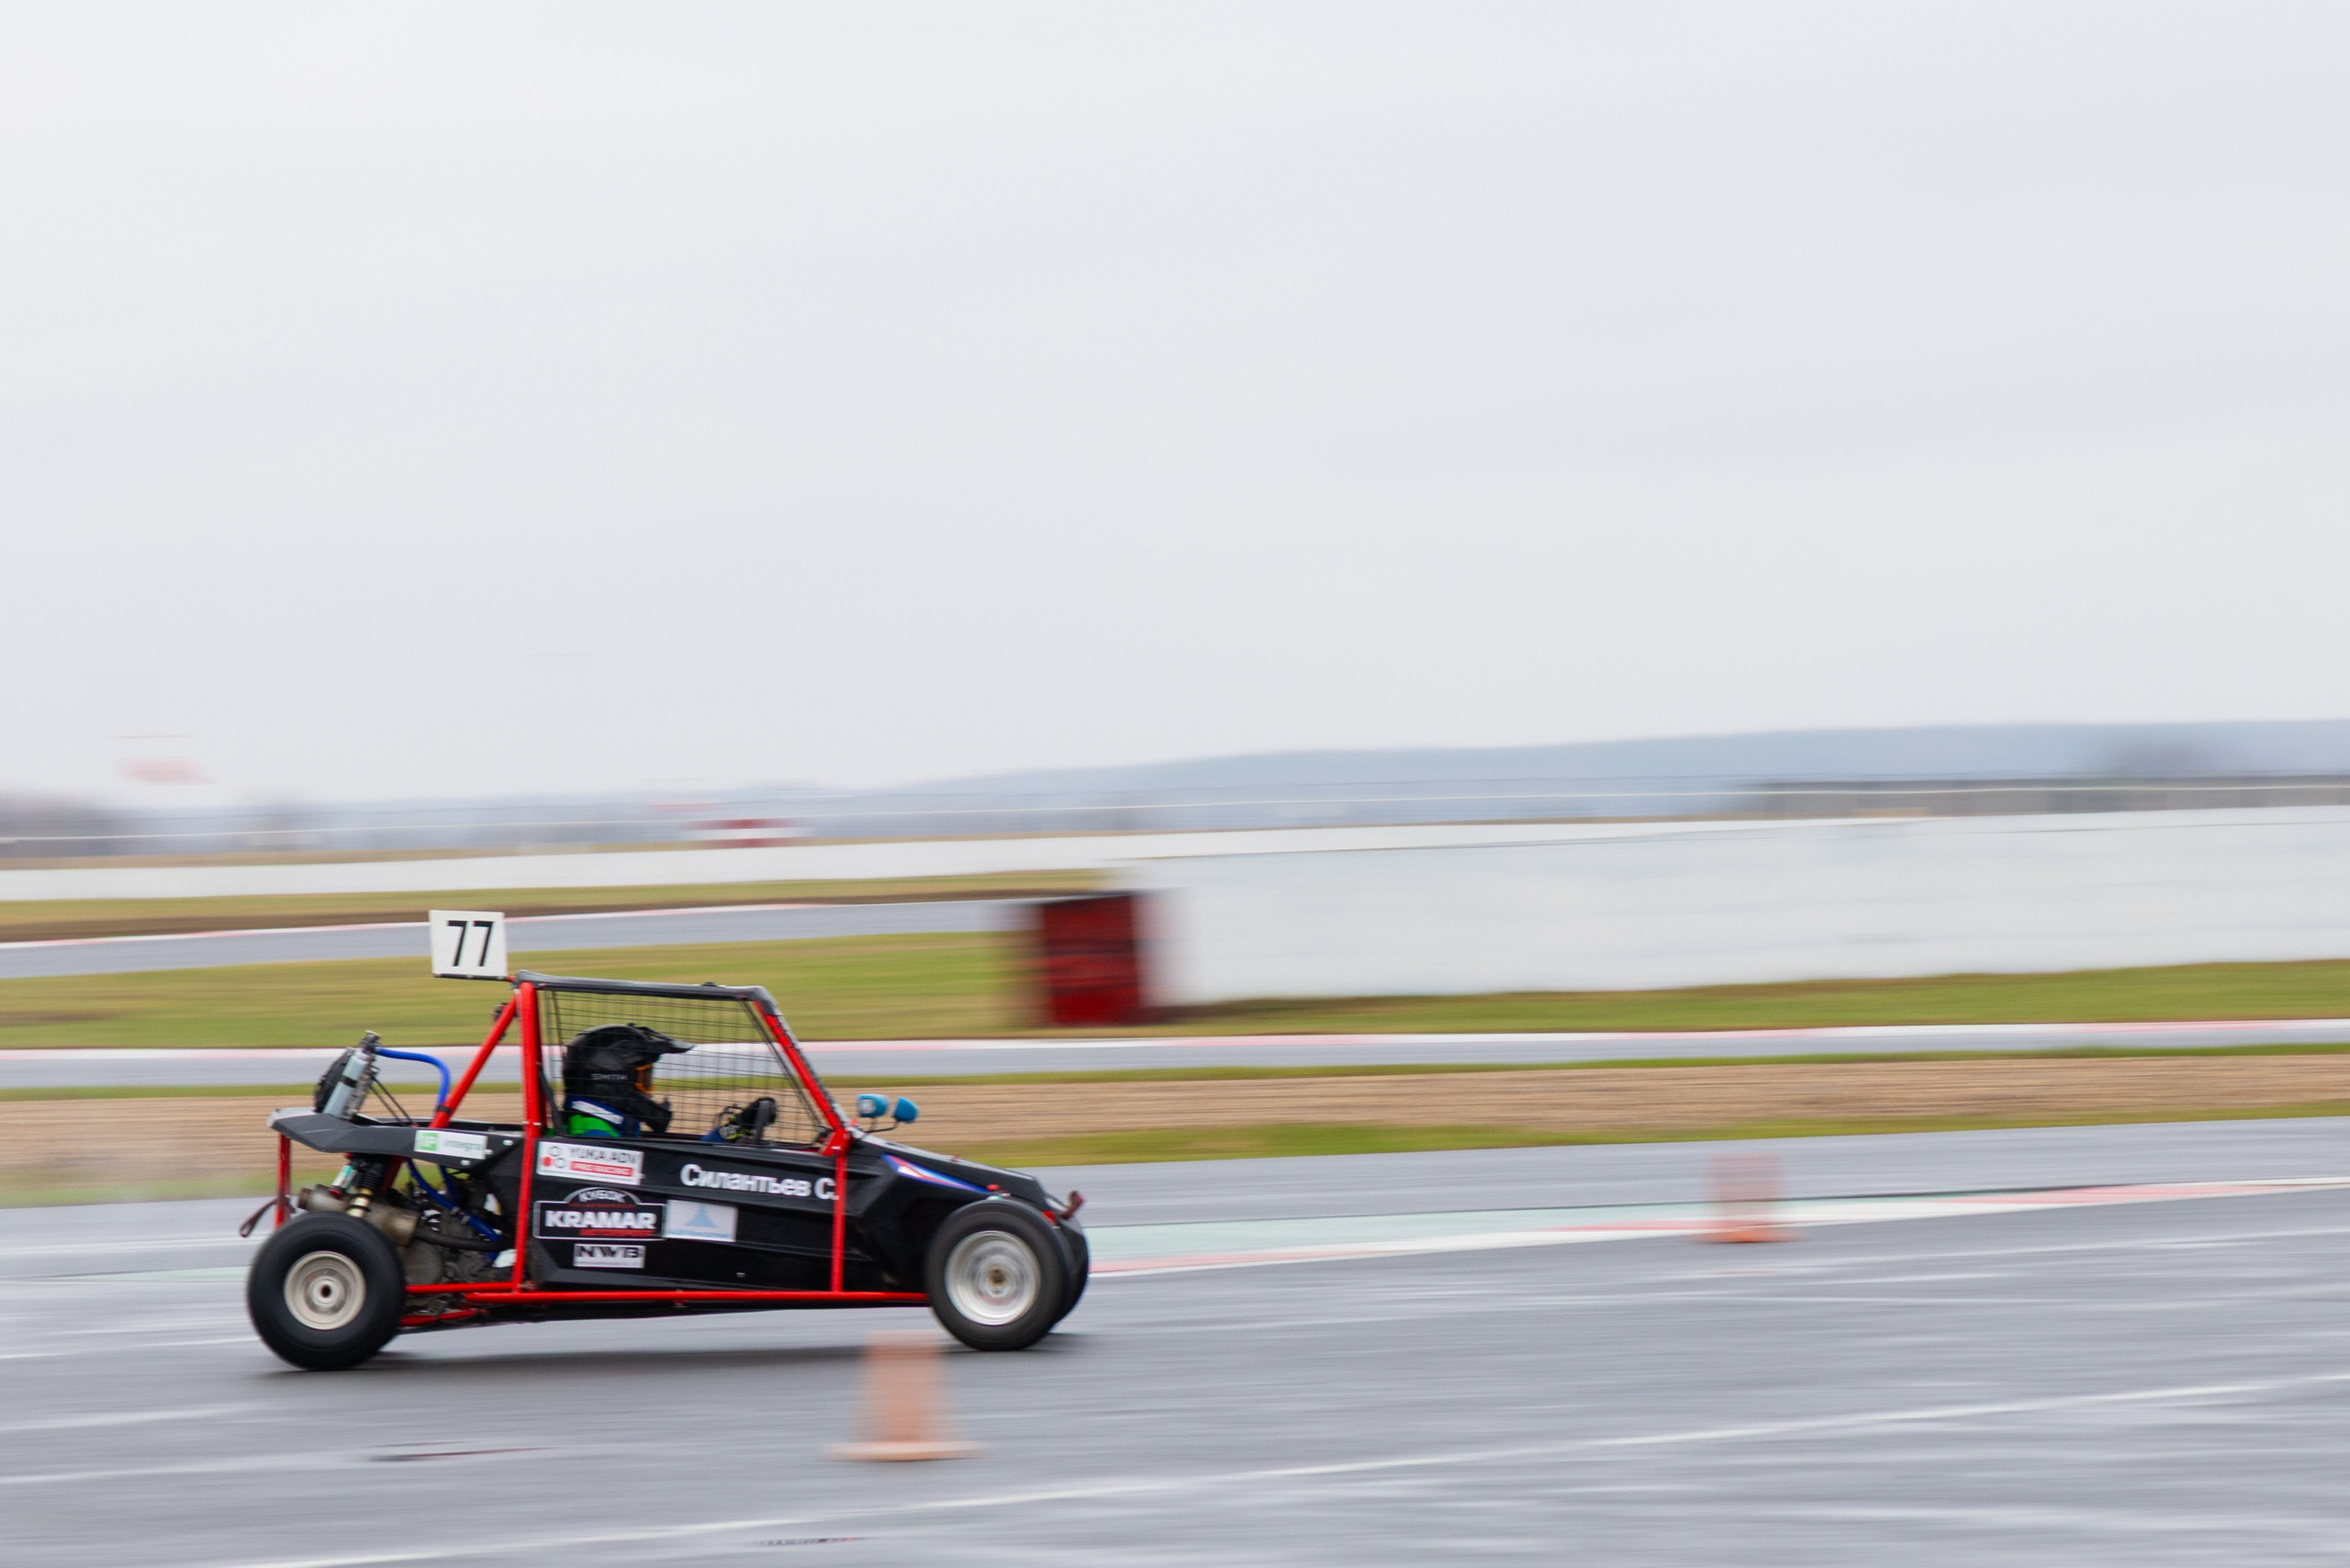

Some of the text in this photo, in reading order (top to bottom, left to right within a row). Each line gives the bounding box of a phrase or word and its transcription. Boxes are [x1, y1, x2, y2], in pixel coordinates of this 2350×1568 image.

[447, 920, 494, 967] 77
[680, 1163, 811, 1197] Силантьев
[544, 1210, 657, 1229] KRAMAR
